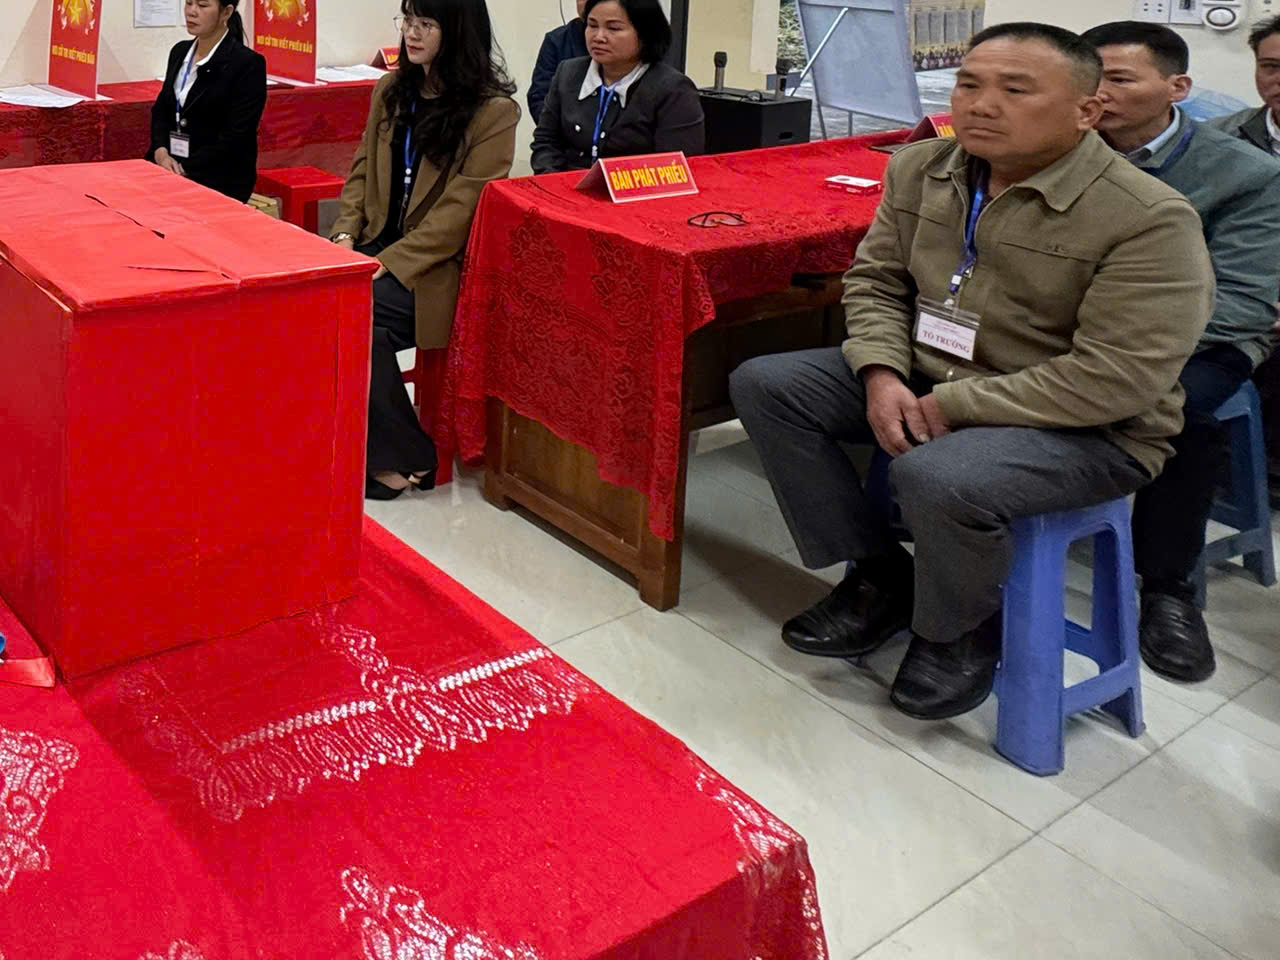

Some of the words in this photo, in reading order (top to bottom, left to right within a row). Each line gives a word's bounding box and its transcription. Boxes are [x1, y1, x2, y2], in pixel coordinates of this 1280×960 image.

[610, 167, 634, 190] BÀN
[632, 164, 659, 188] PHÁT
[657, 159, 688, 184] PHIẾU
